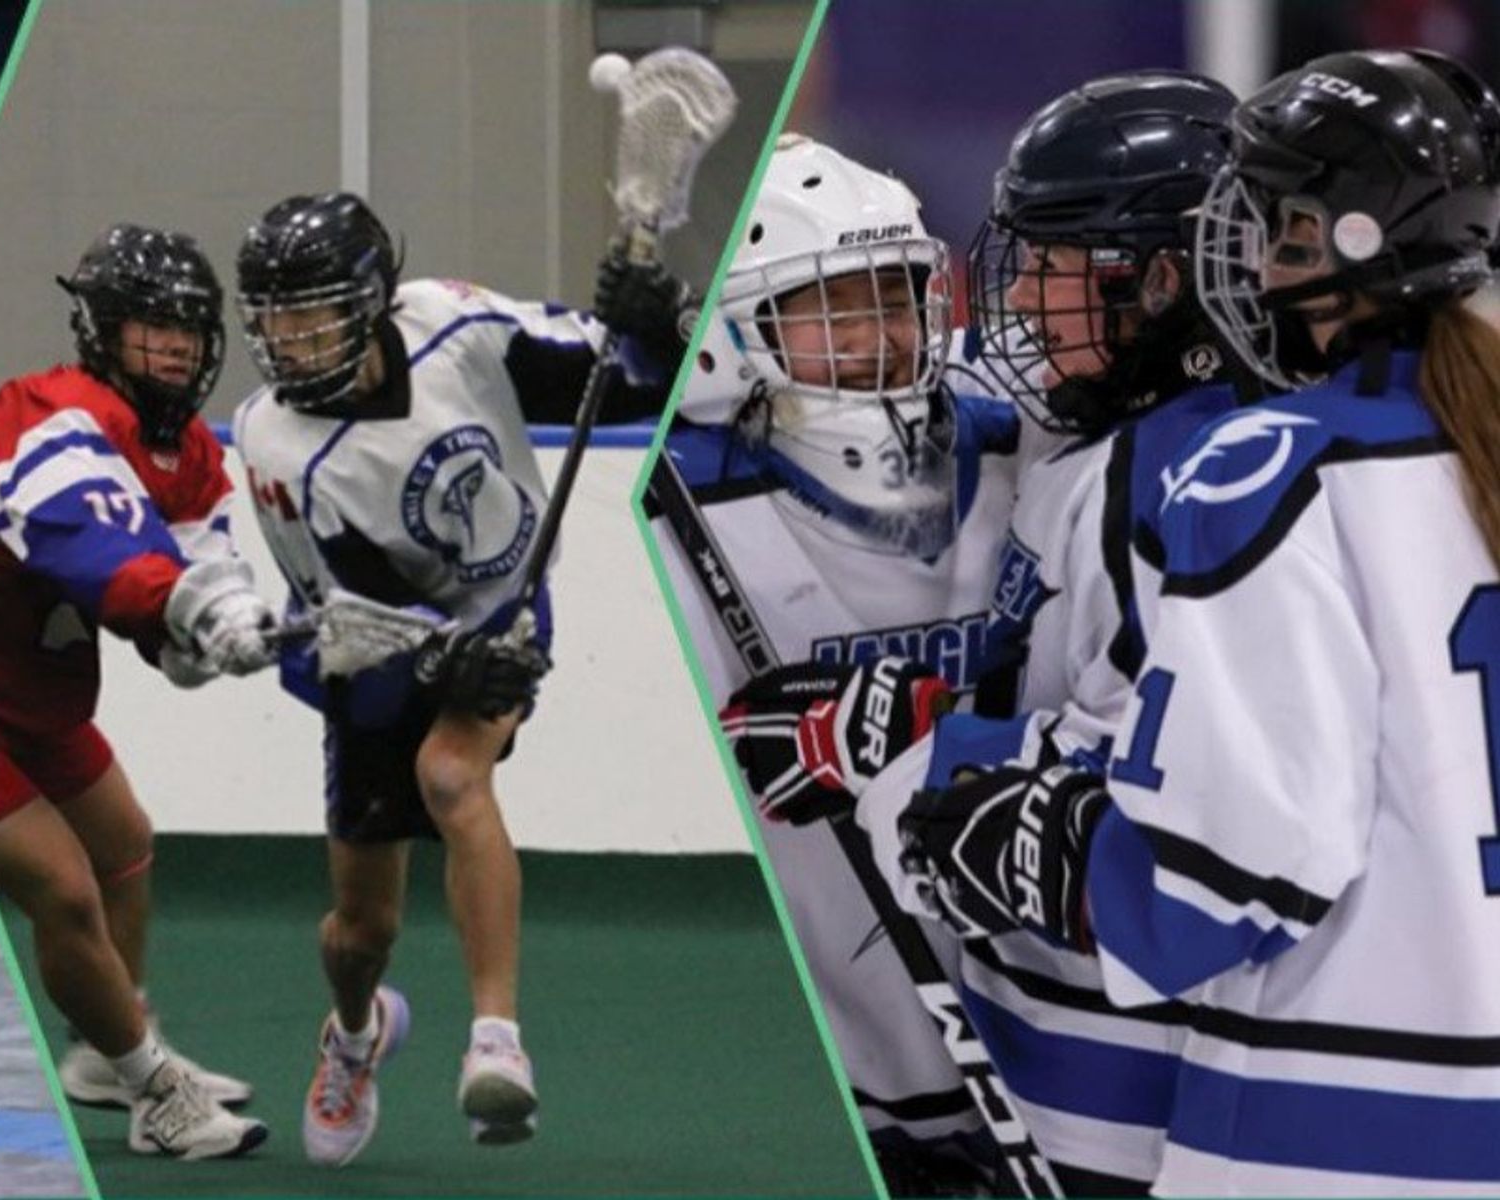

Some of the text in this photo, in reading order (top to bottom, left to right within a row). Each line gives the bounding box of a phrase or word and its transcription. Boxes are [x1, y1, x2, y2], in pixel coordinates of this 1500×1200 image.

[1301, 73, 1378, 107] CCM
[838, 223, 912, 246] BAUER
[82, 490, 146, 536] 17
